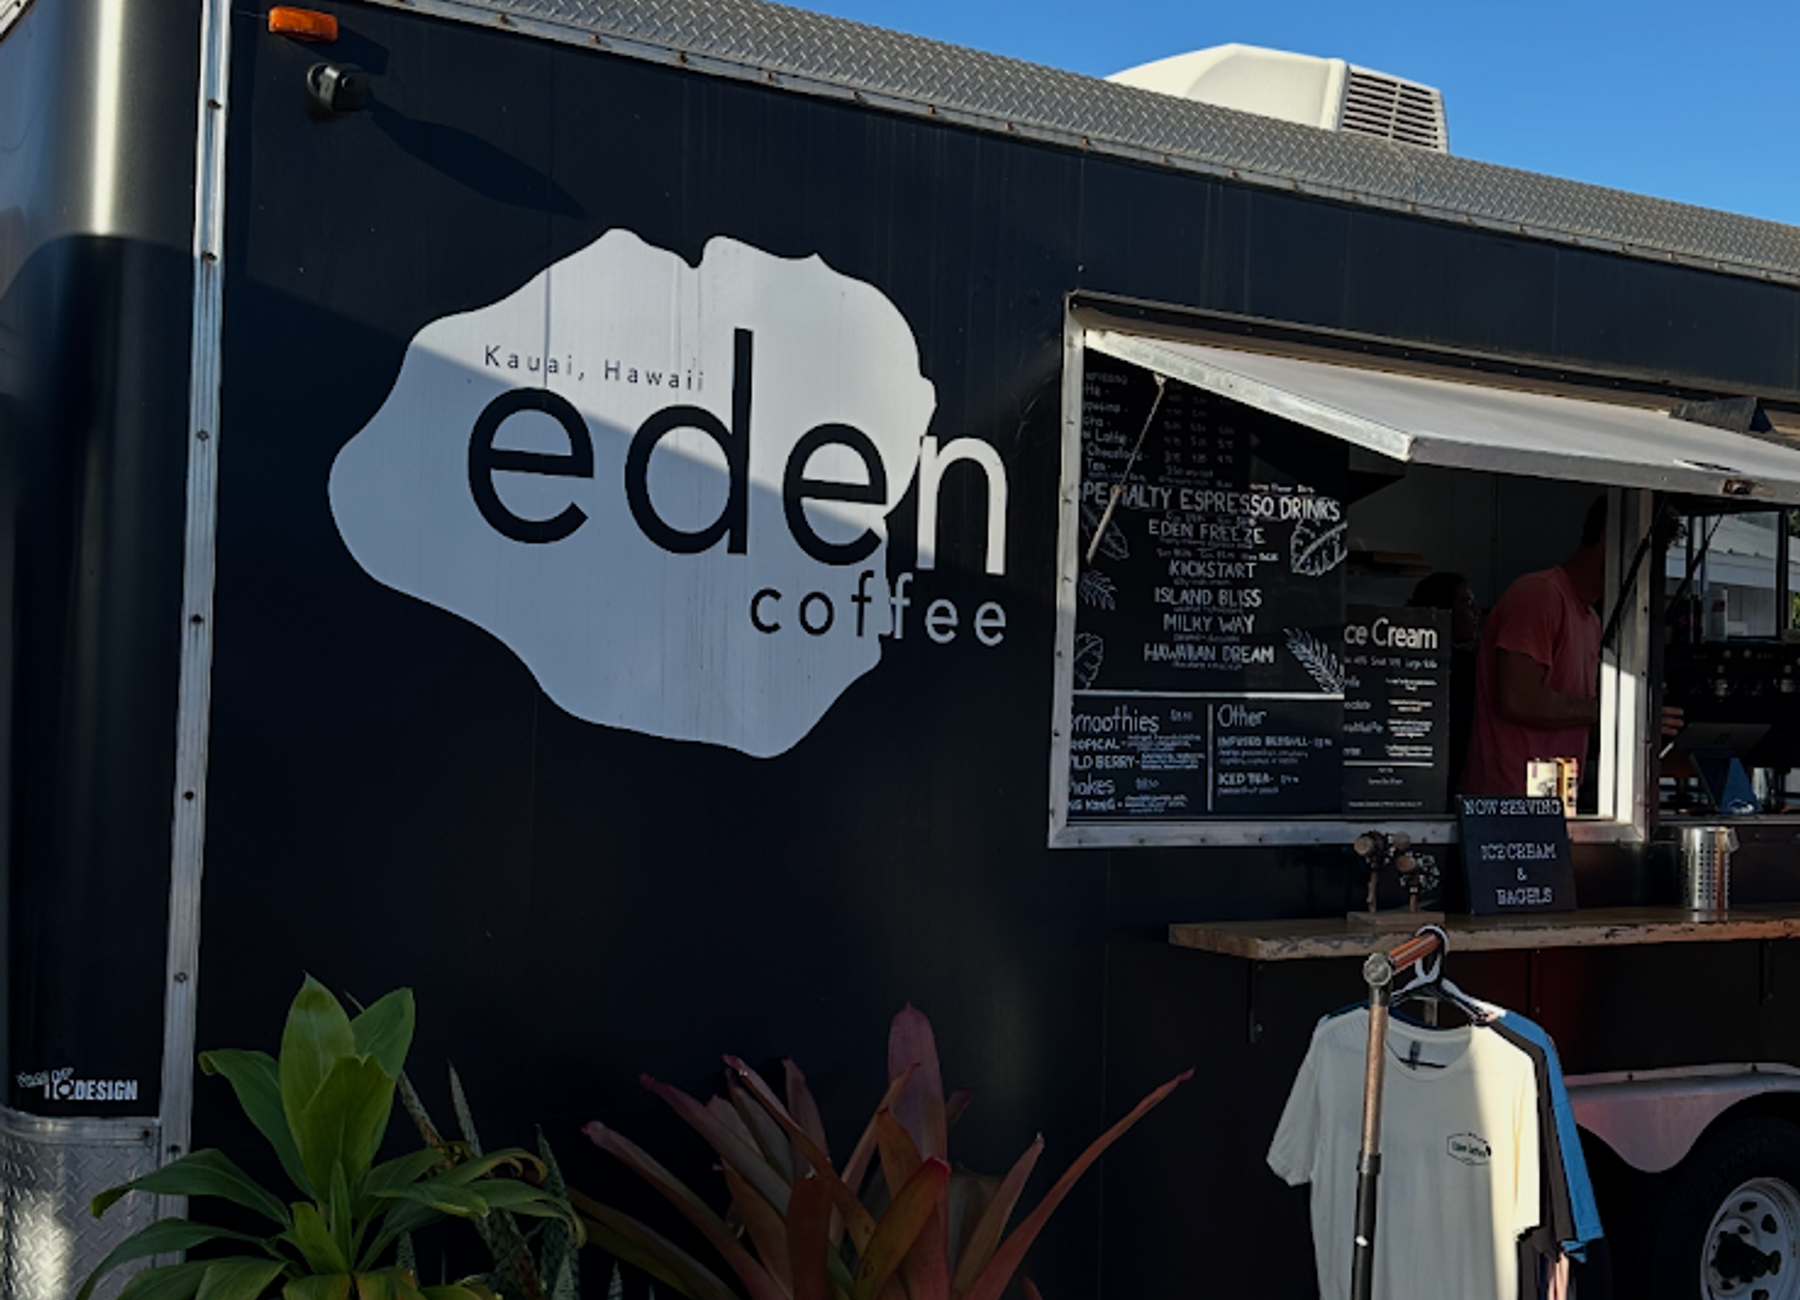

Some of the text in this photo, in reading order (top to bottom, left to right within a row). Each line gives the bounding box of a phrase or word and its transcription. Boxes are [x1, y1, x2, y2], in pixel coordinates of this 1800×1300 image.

[484, 343, 704, 392] Kauai, Hawaii
[467, 326, 1008, 576] eden
[1081, 480, 1173, 511] PEIALTY
[1180, 488, 1275, 516] ESPRESSO
[1279, 494, 1341, 522] DRINKS
[1148, 518, 1194, 538] EDEN
[1199, 522, 1266, 544] FREEZE
[1168, 559, 1257, 579] KICKSTART
[749, 569, 1007, 646] coffee
[1154, 586, 1263, 608] ISLAND BLISS
[1162, 613, 1256, 635] MILKY WAY
[1343, 616, 1438, 650] ce Cream
[1222, 644, 1276, 664] DREAM
[1073, 704, 1161, 733] moothies
[1216, 703, 1268, 728] Other
[1463, 798, 1562, 816] NOW SERVING
[1480, 842, 1557, 861] ICE CREAM
[1516, 866, 1527, 882] &
[1495, 886, 1553, 906] BAGELS
